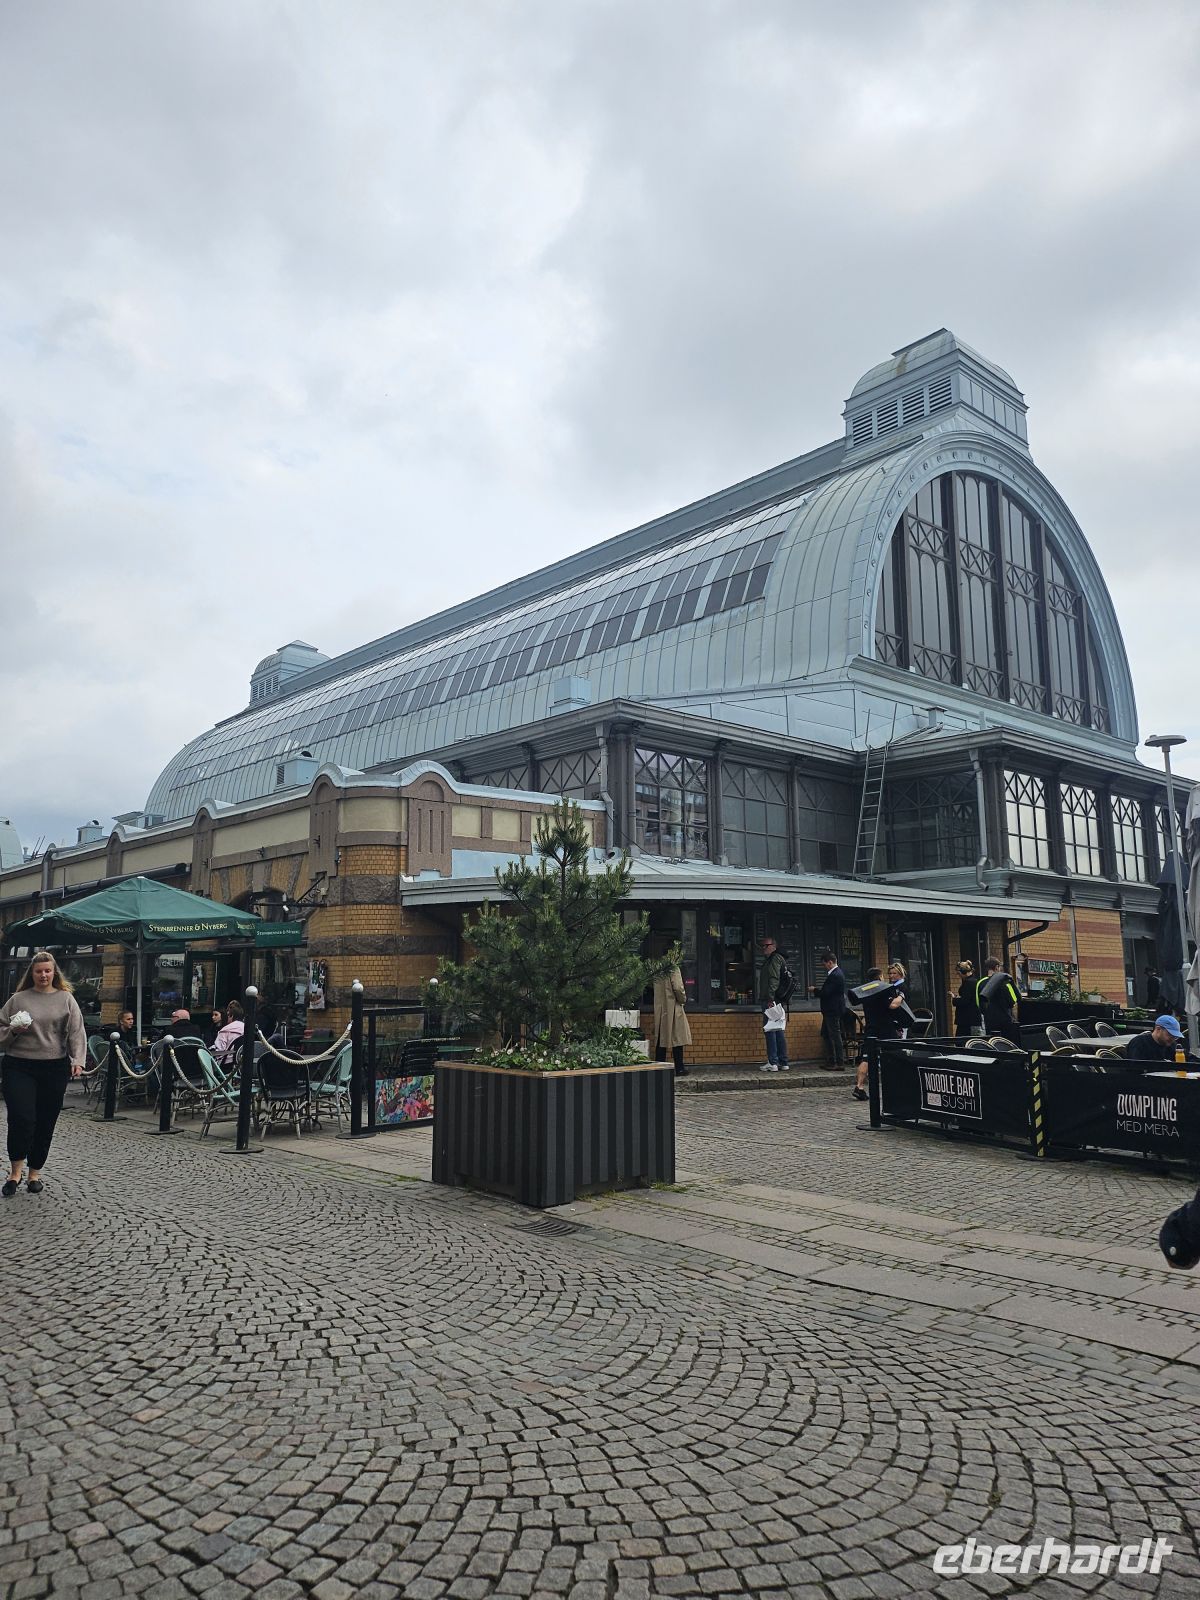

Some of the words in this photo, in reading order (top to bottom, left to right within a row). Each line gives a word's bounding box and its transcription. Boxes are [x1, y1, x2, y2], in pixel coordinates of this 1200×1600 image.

[148, 924, 194, 932] STEINBRENNER
[194, 923, 201, 931] &
[201, 922, 228, 931] NYBERG
[924, 1072, 956, 1095] NOODLE
[956, 1076, 975, 1098] BAR
[942, 1094, 976, 1112] SUSHI
[1117, 1093, 1177, 1122] DUMPLING
[1116, 1119, 1142, 1133] MED
[1144, 1122, 1180, 1138] MERA
